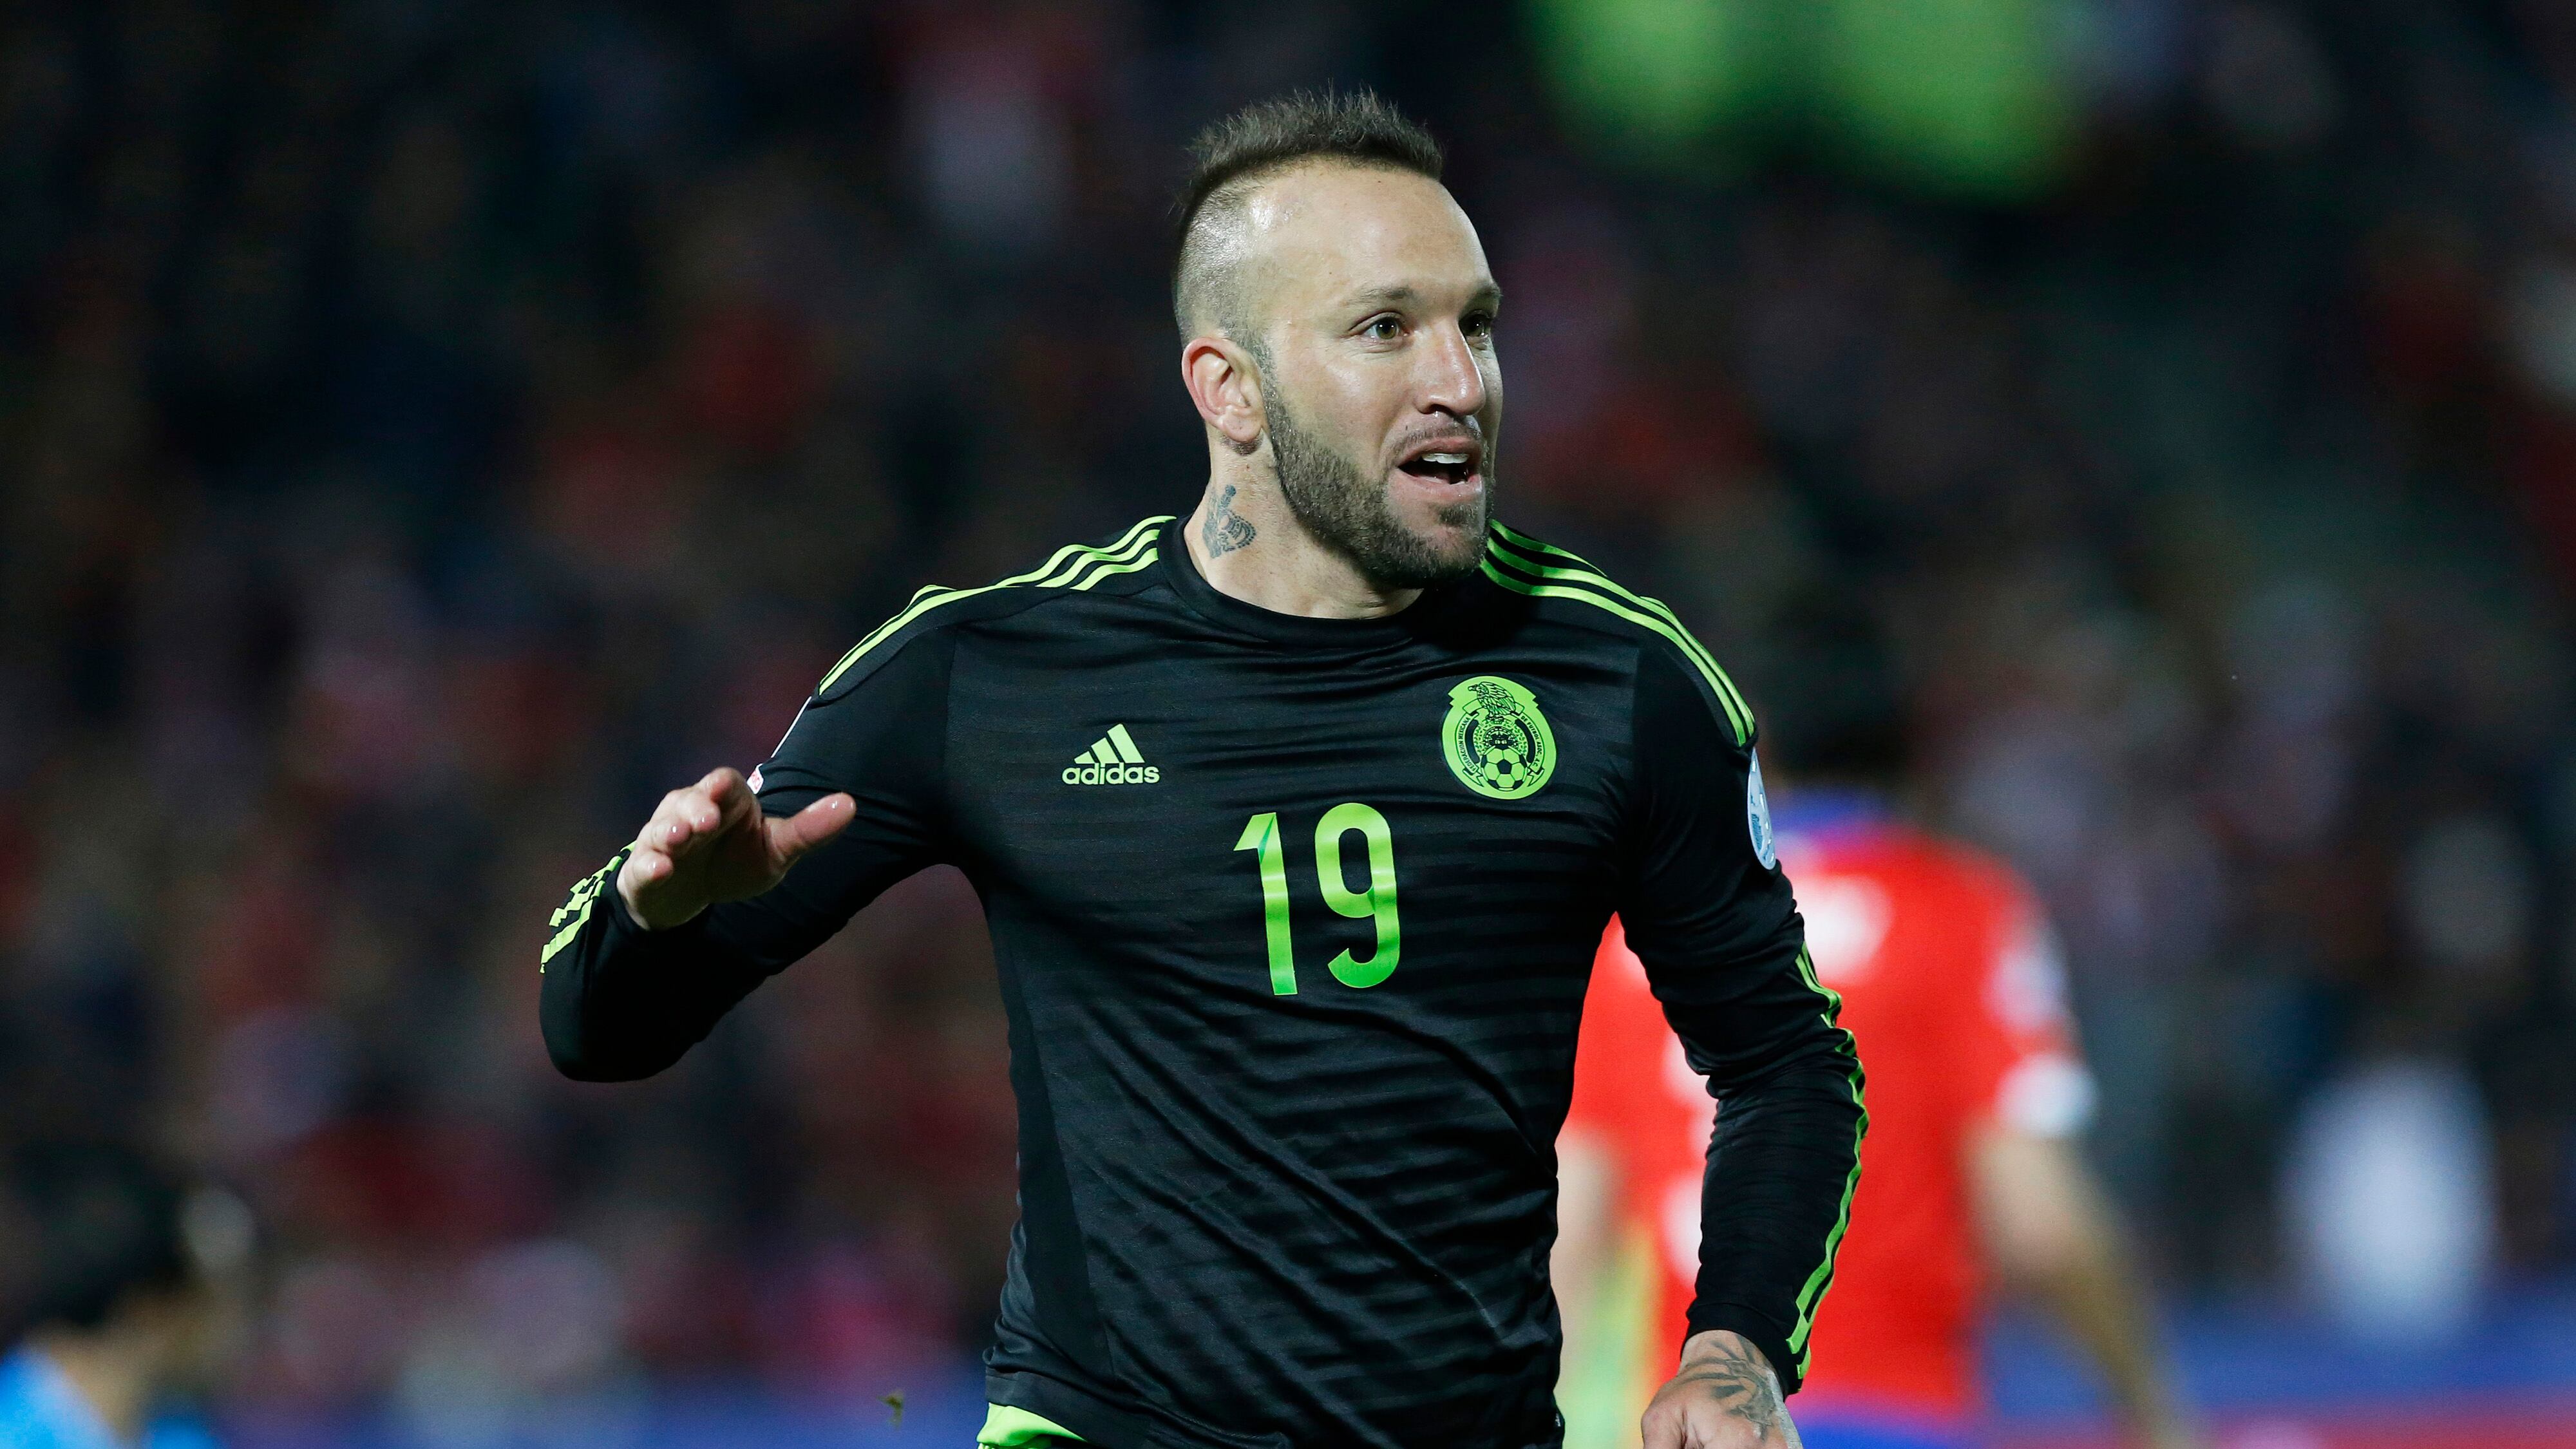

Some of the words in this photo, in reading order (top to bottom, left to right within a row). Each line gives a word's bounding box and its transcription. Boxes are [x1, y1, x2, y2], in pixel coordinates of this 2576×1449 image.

[1527, 722, 1540, 739] FUTBOL
[1062, 762, 1160, 784] adidas
[1233, 802, 1400, 995] 19
